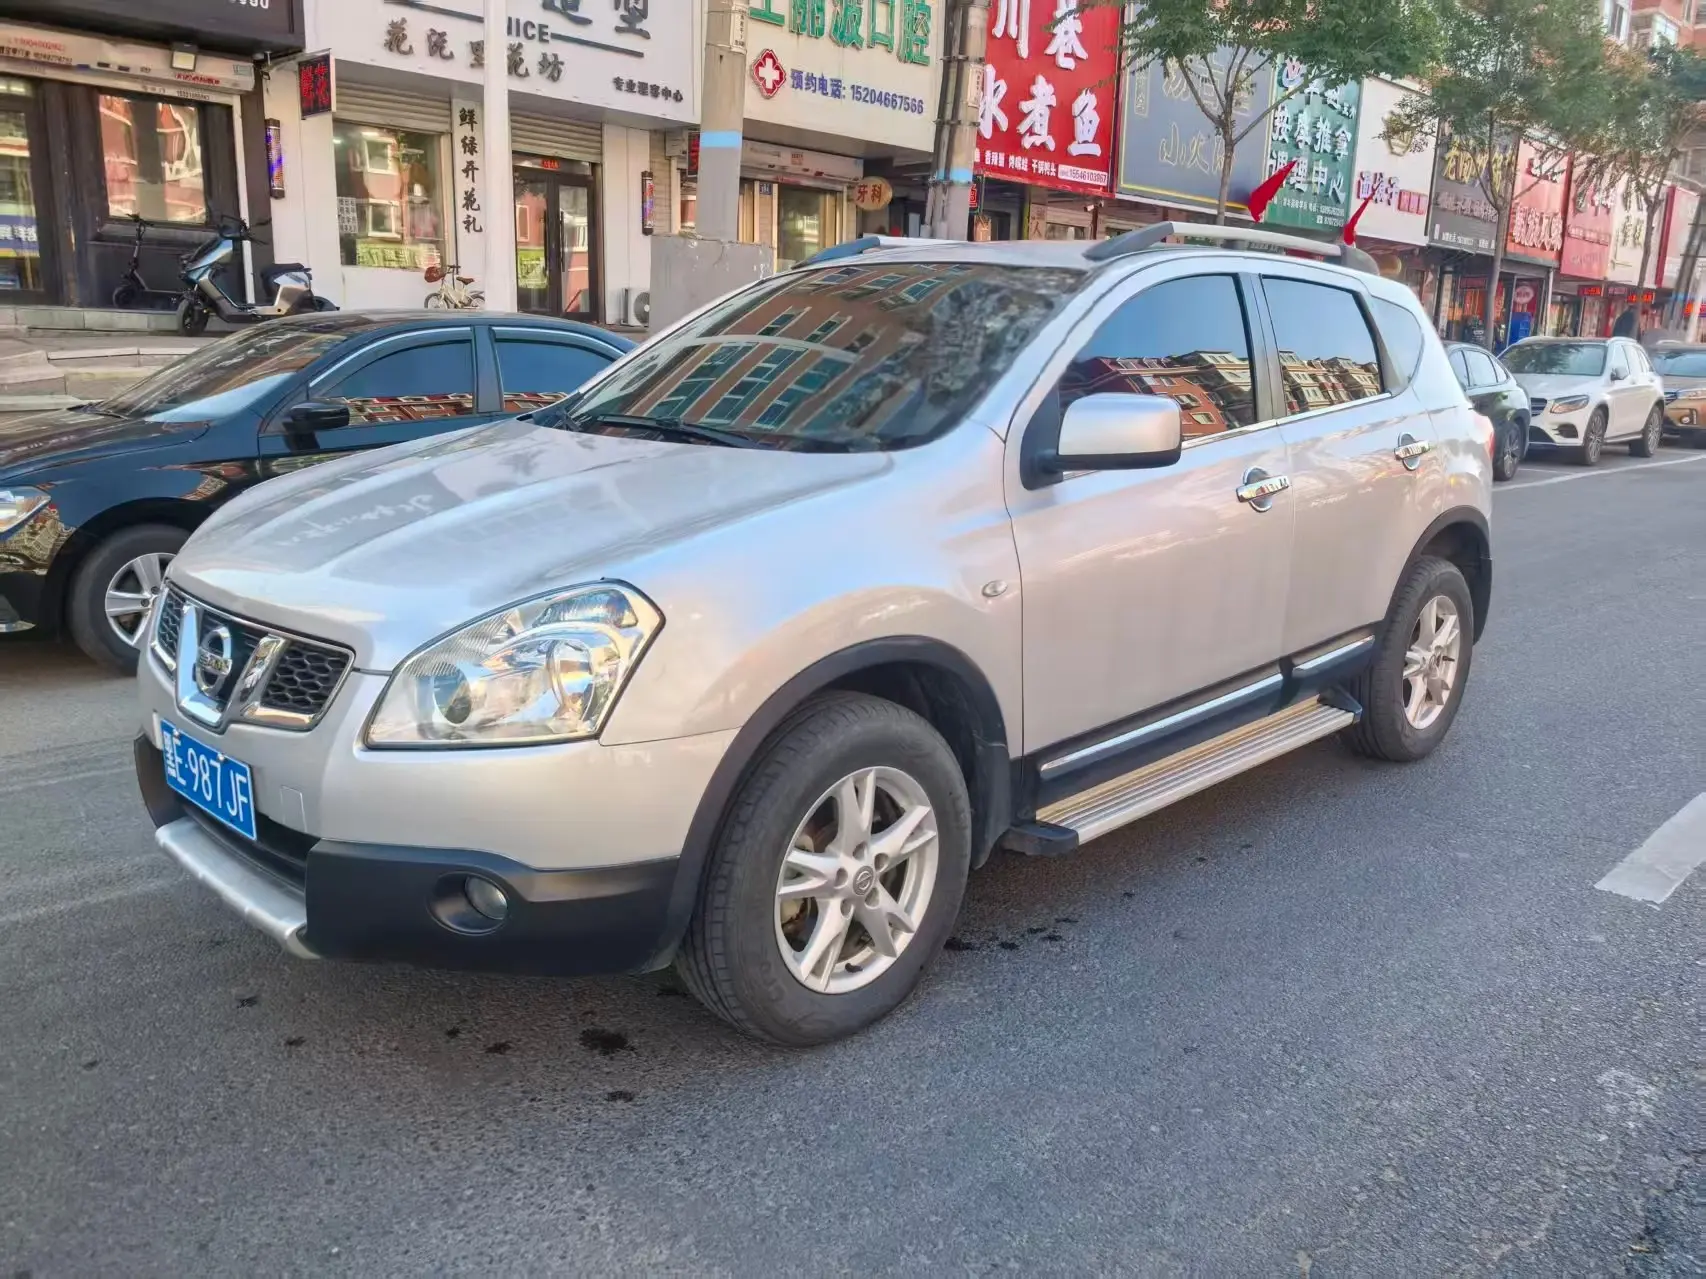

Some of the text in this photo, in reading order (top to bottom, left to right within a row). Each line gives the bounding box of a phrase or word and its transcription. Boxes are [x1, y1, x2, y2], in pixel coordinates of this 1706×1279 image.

[979, 63, 1102, 157] 水煮鱼
[857, 183, 882, 205] 牙科
